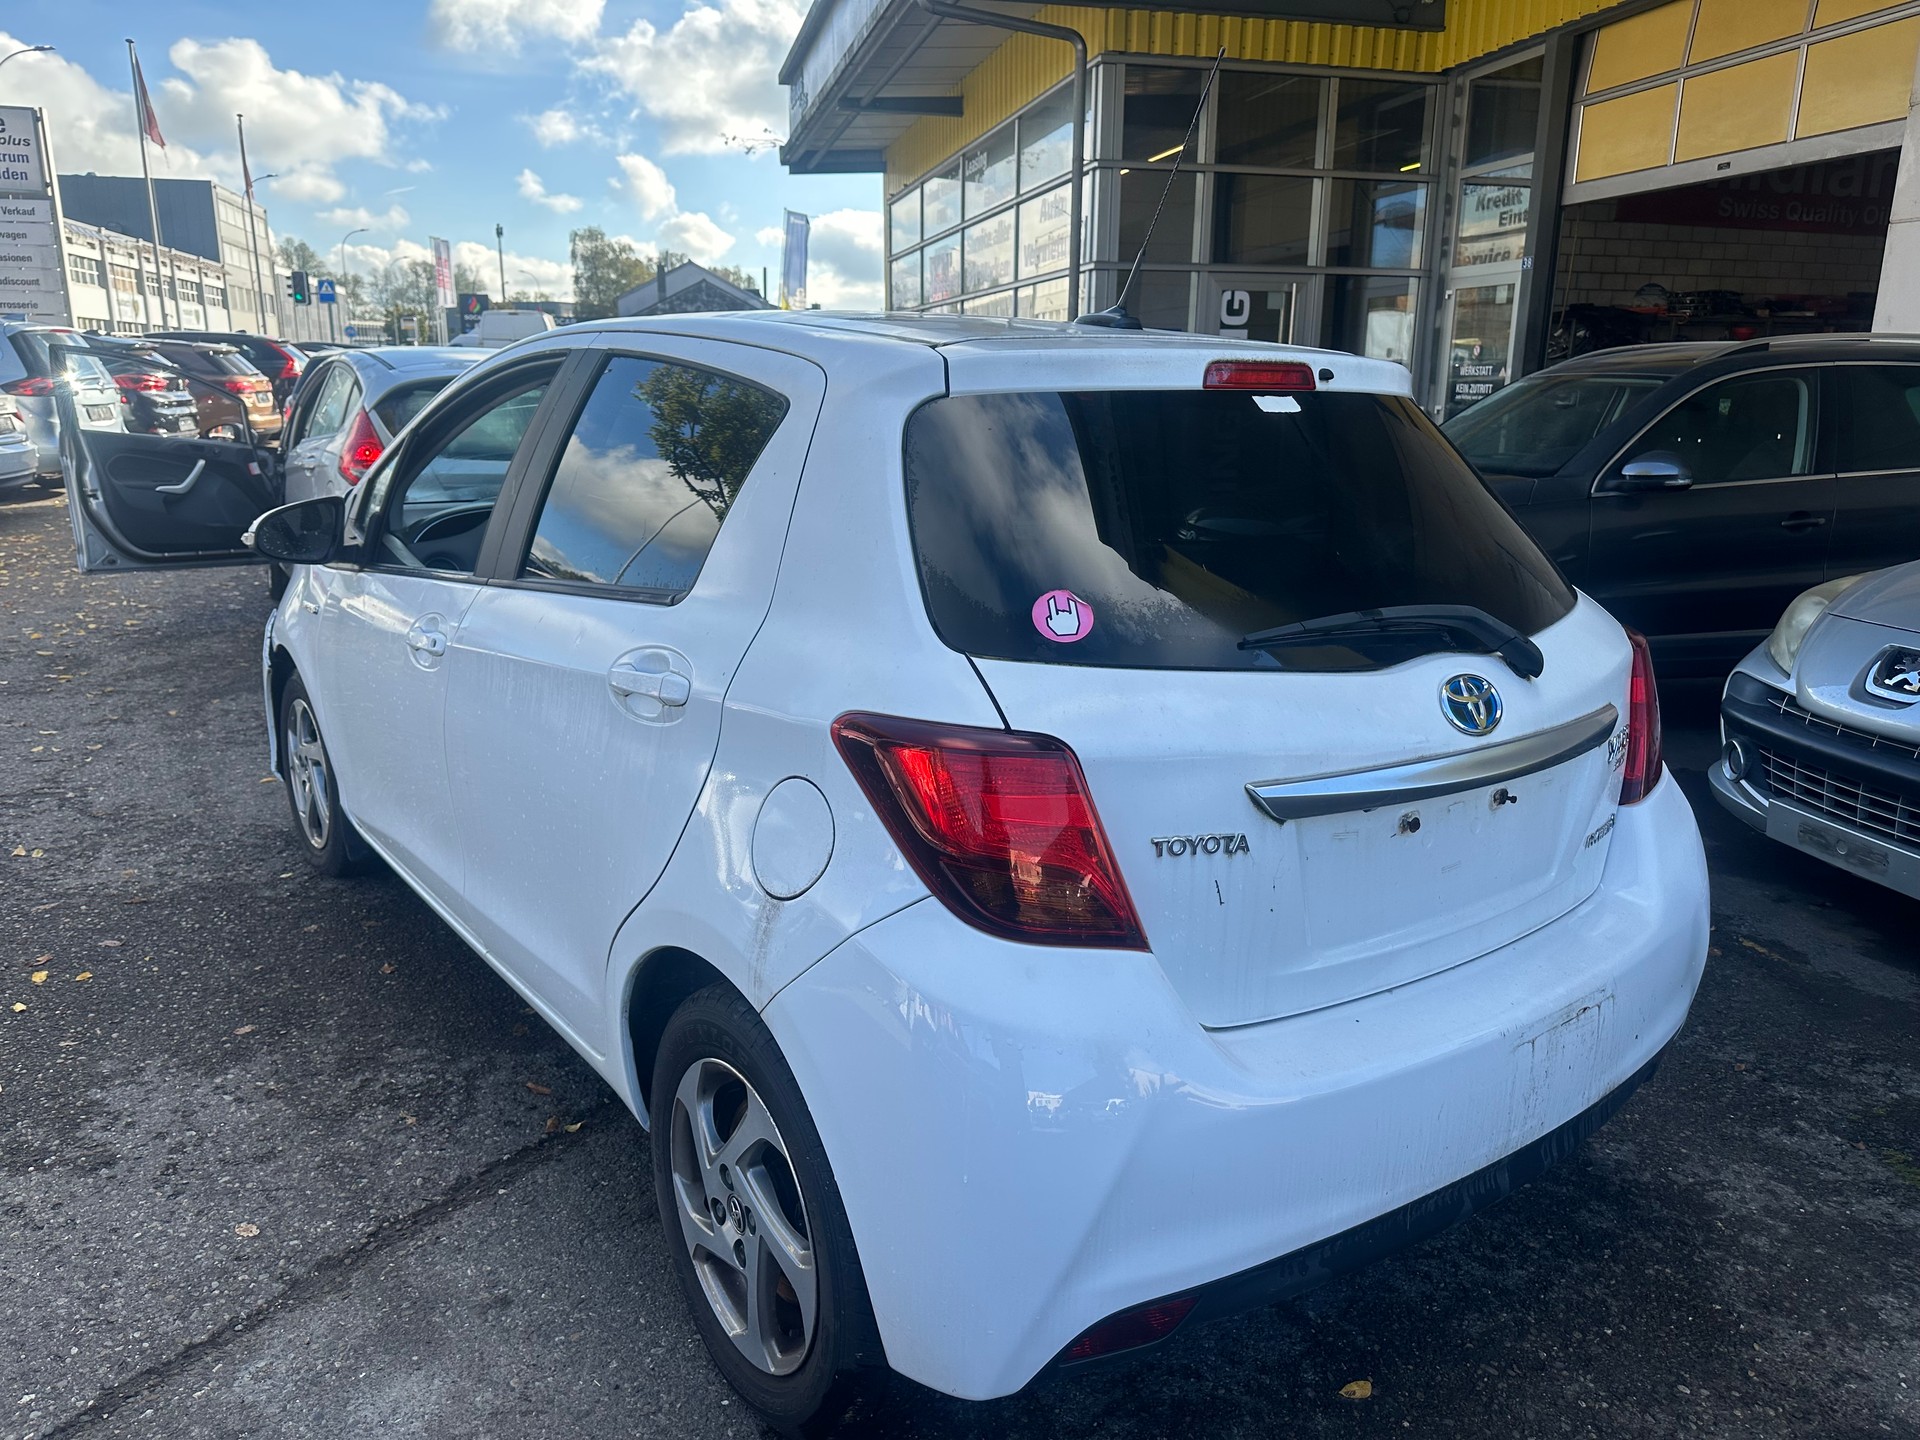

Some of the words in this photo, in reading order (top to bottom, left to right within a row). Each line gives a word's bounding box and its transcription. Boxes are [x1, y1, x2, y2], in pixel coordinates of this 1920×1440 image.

[0, 167, 28, 181] den
[1475, 187, 1523, 212] Kredit
[0, 206, 36, 216] Verkauf
[1718, 197, 1780, 220] Swiss
[1785, 201, 1858, 228] Quality
[1523, 257, 1532, 269] 38
[1459, 365, 1493, 377] WERKSTATT
[1455, 383, 1469, 394] KEIN
[1469, 383, 1494, 394] ZUTRITT
[1151, 833, 1250, 858] TOYOTA
